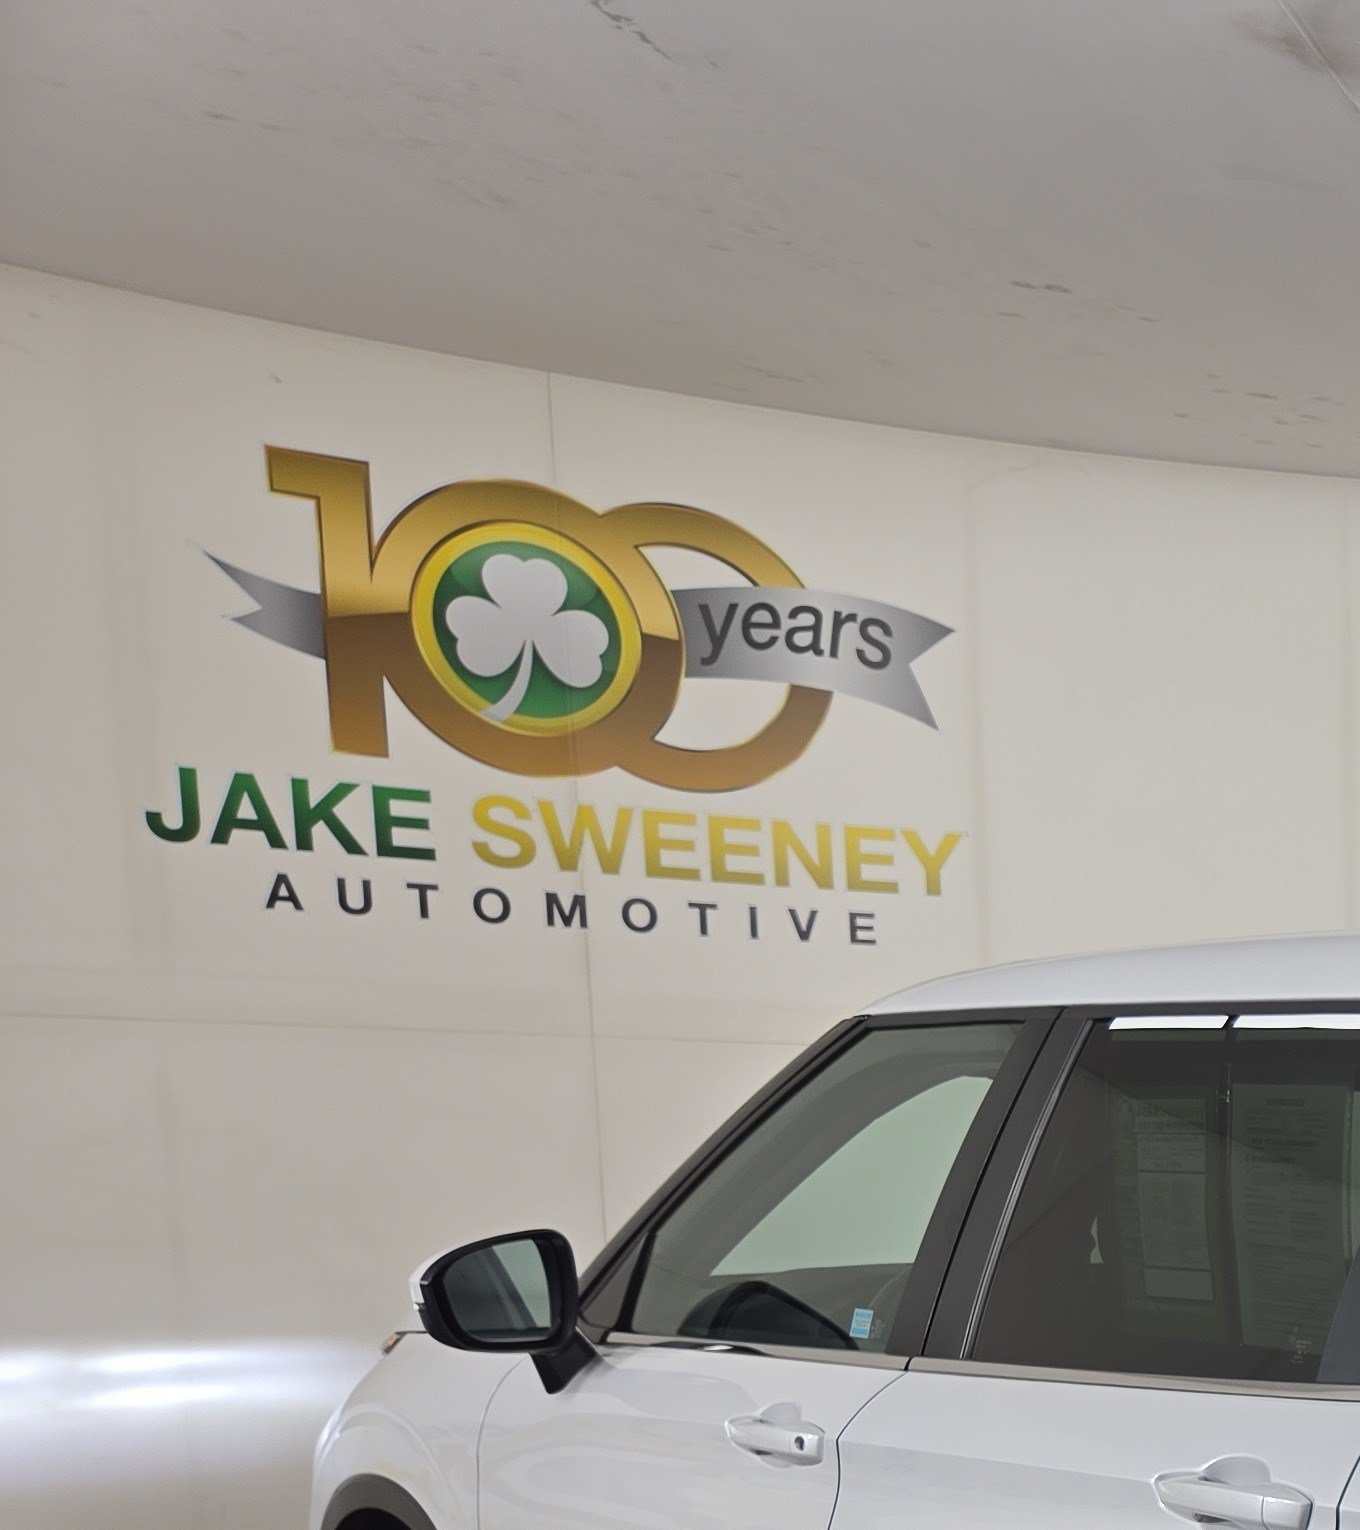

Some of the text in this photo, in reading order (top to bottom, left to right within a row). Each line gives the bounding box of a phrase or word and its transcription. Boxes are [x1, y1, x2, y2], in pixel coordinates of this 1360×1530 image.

[264, 443, 895, 793] 100 years
[145, 764, 963, 898] JAKE SWEENEY
[265, 872, 879, 947] AUTOMOTIVE
